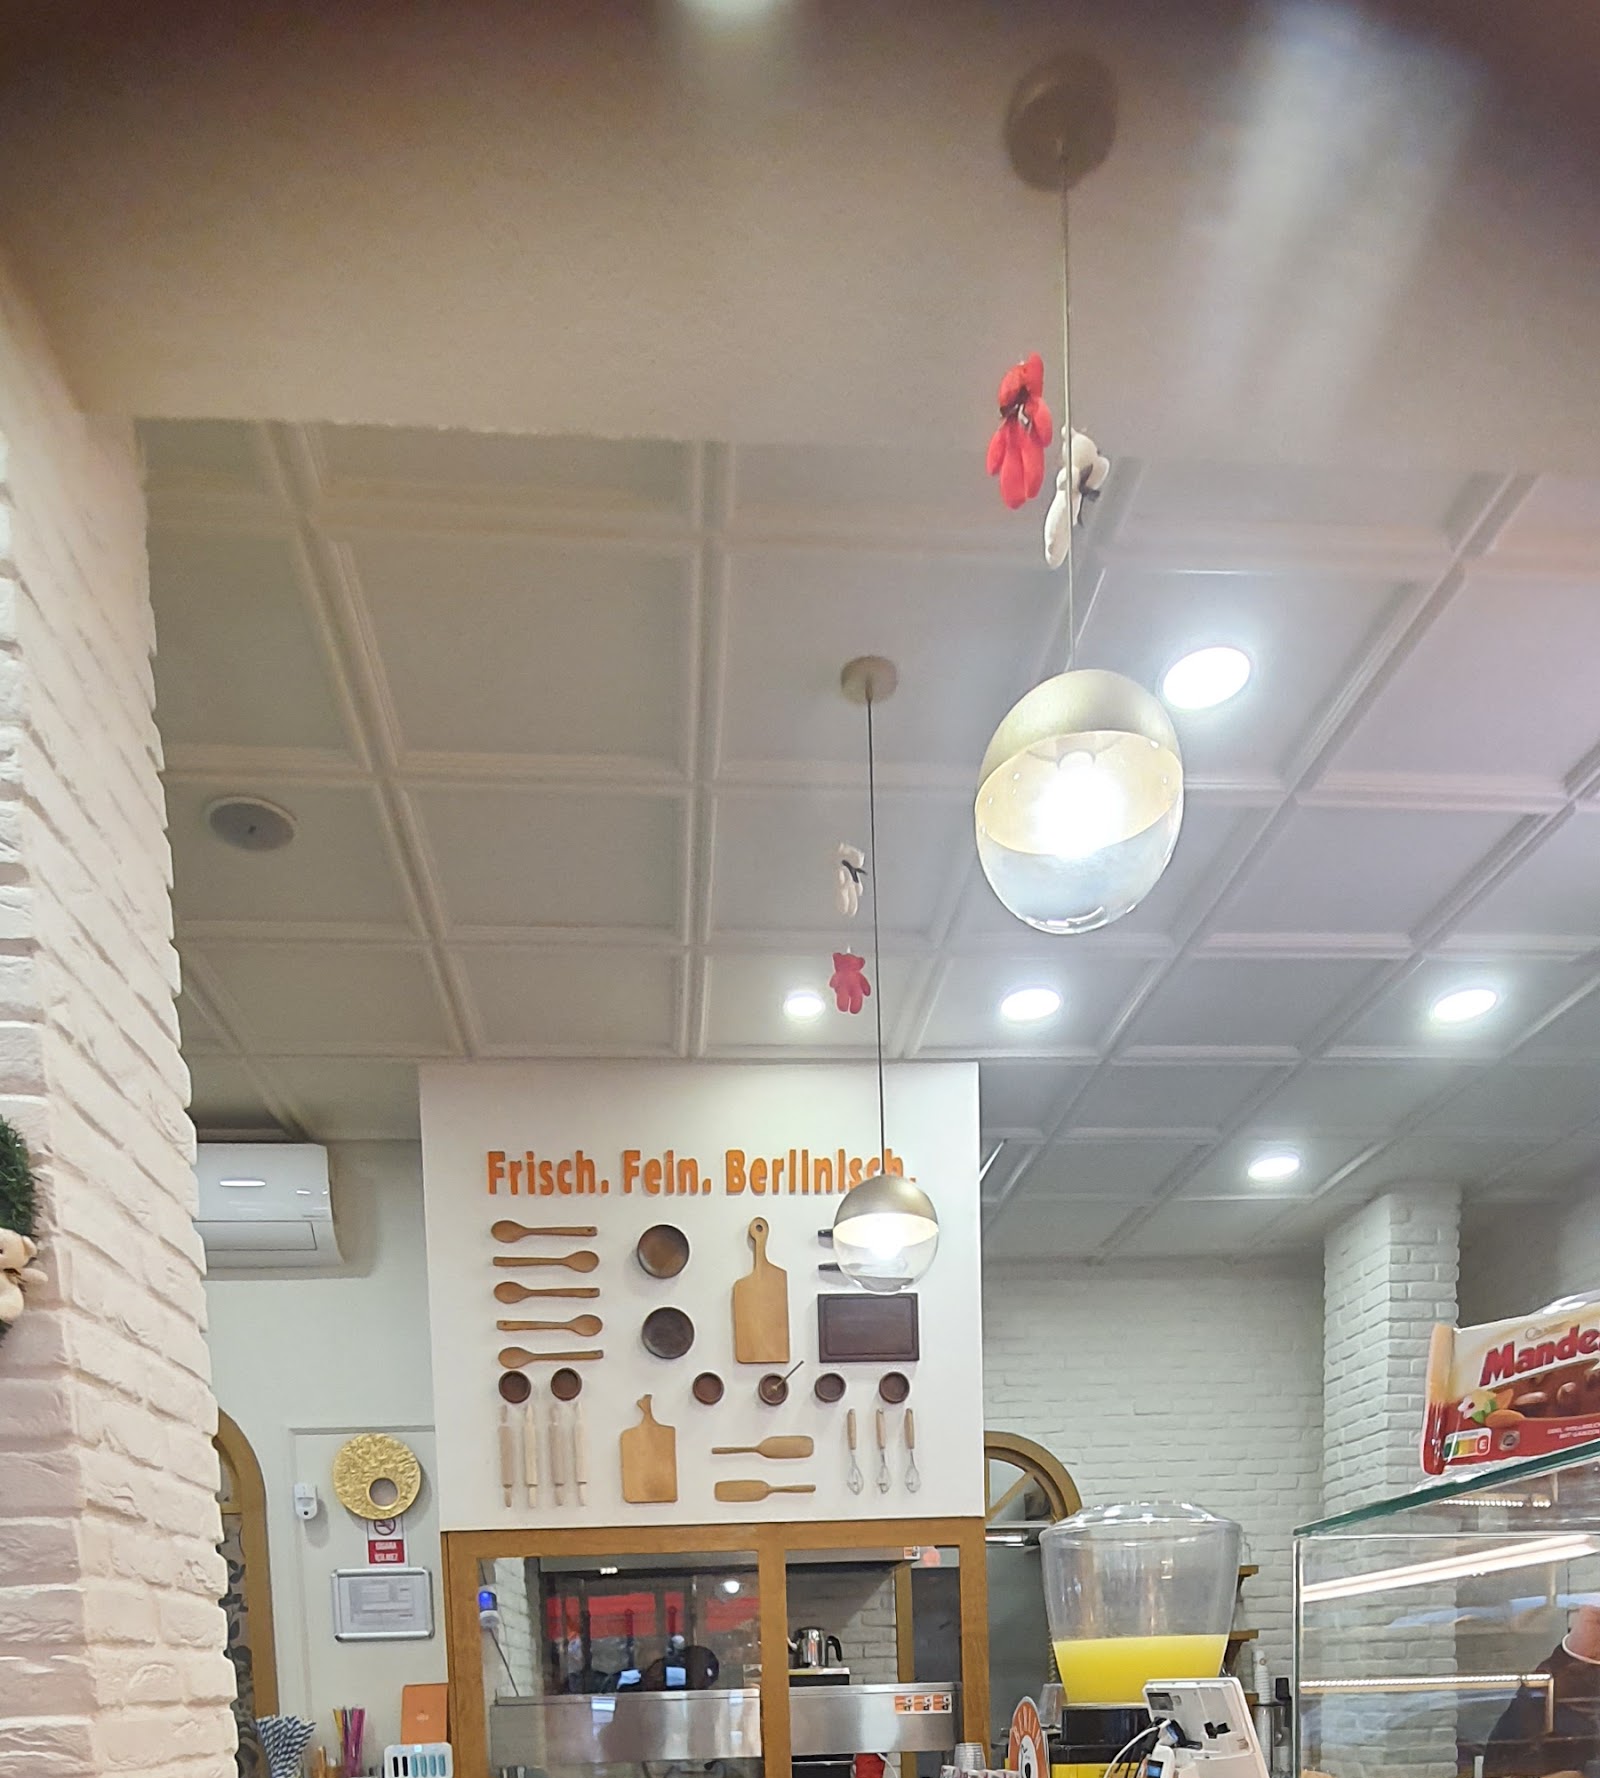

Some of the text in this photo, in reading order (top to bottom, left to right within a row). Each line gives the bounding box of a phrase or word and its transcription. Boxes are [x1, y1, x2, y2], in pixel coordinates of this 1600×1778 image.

[487, 1150, 610, 1196] Frisch.
[622, 1149, 712, 1195] Fein.
[1478, 1324, 1600, 1387] Mande
